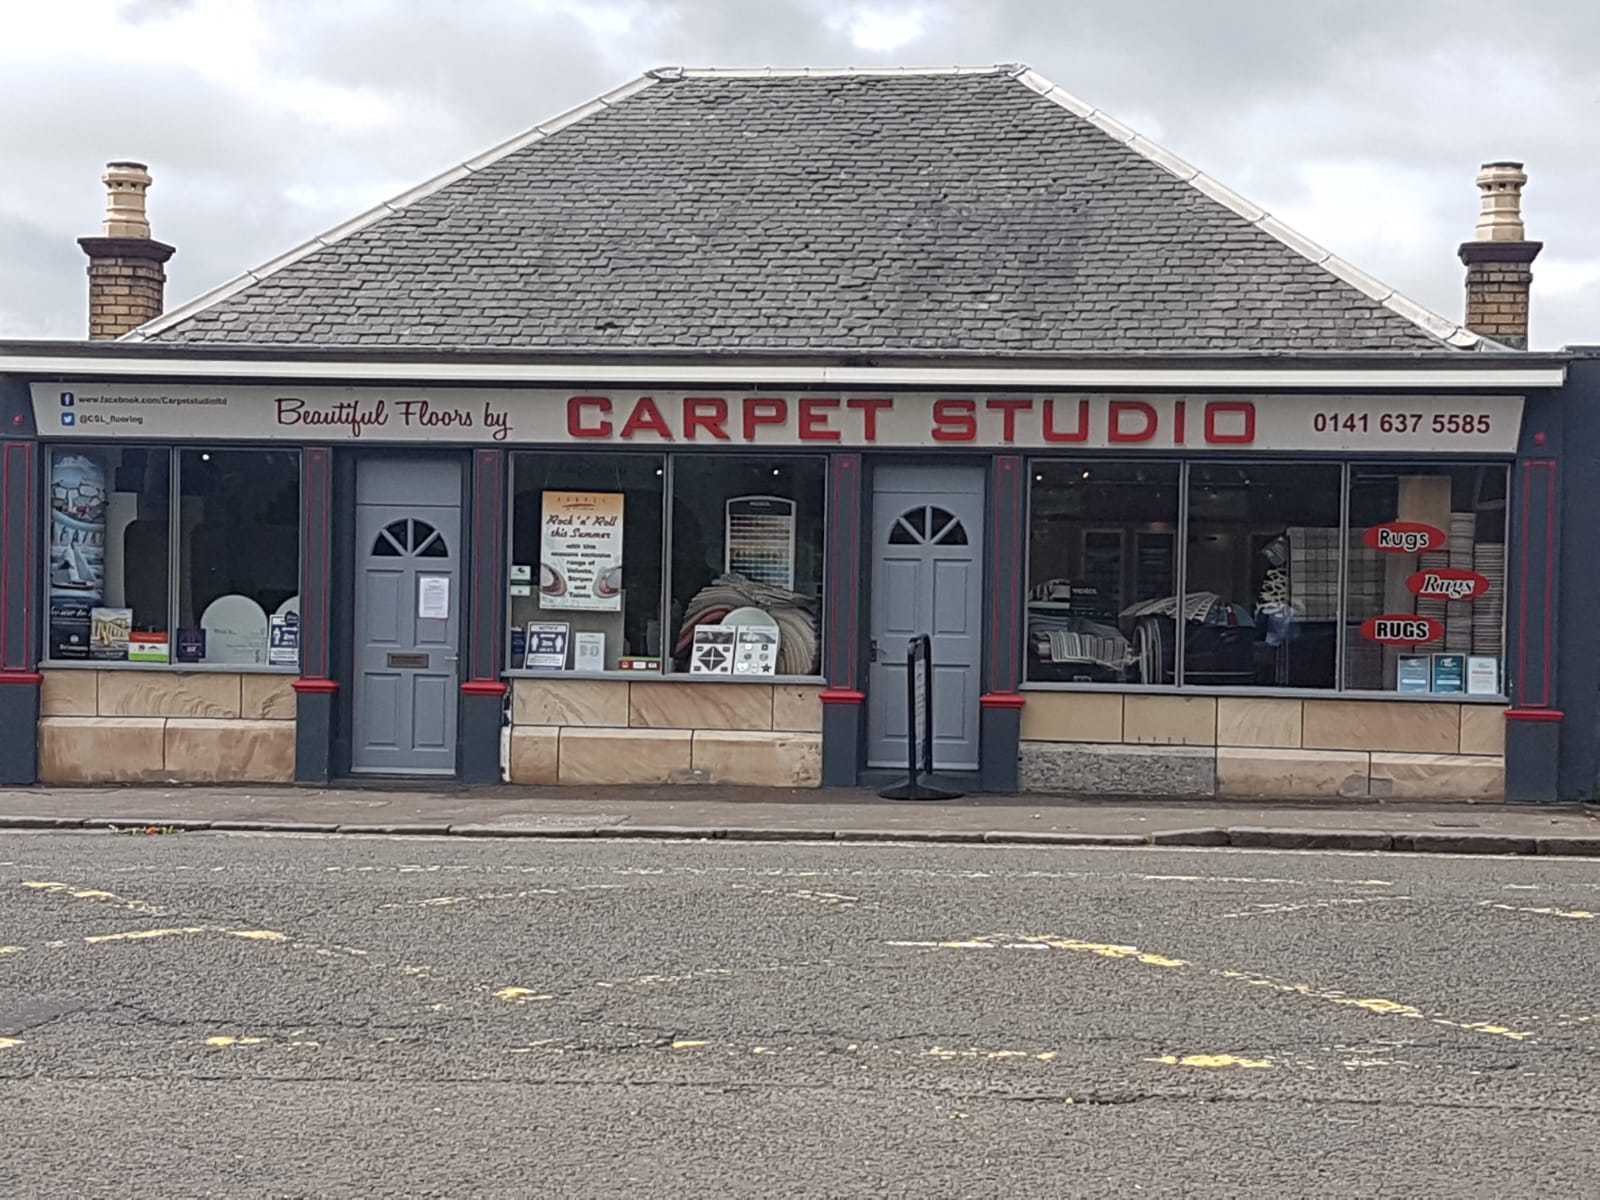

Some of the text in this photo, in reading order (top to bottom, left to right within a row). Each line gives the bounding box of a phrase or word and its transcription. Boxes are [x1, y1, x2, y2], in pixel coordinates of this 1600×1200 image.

[274, 396, 1256, 444] Beautiful Floors by CARPET STUDIO
[1313, 412, 1491, 434] 0141 637 5585
[546, 514, 573, 526] Rock
[592, 515, 618, 527] Roll
[551, 527, 611, 539] this Summer
[1379, 529, 1429, 550] Rugs
[1421, 575, 1474, 598] Rugs
[1376, 622, 1428, 639] RUGS
